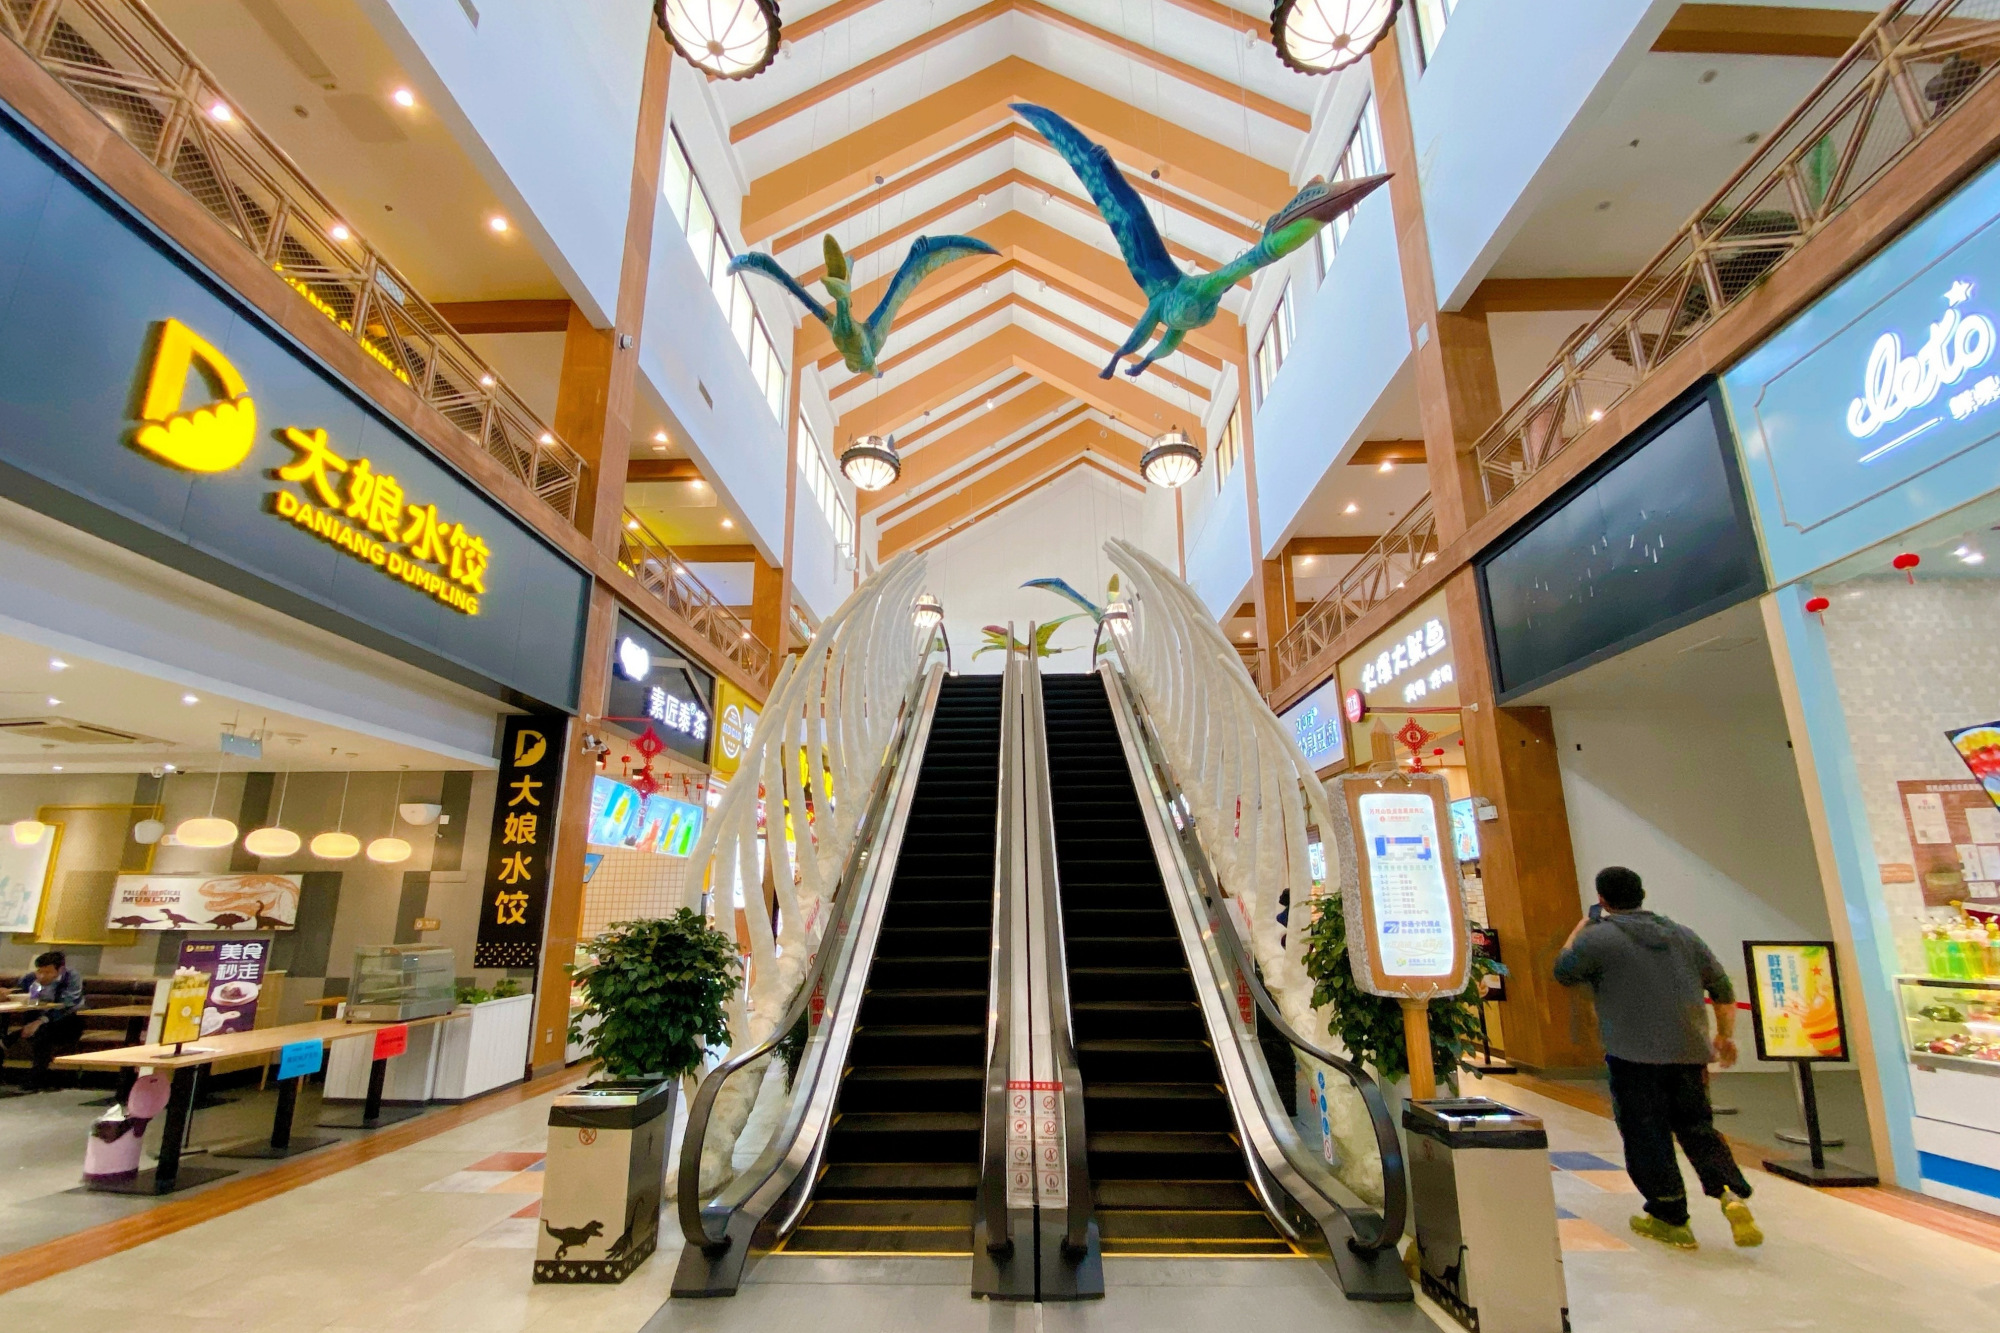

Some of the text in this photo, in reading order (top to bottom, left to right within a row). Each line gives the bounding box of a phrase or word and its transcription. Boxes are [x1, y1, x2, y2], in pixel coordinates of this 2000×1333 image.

[277, 425, 490, 595] 大娘水饺
[277, 489, 481, 617] DANIANG DUMPLING
[495, 773, 544, 926] 大娘水饺
[121, 896, 181, 904] MUSEUM
[215, 963, 260, 981] 秒走
[219, 943, 264, 960] 美食
